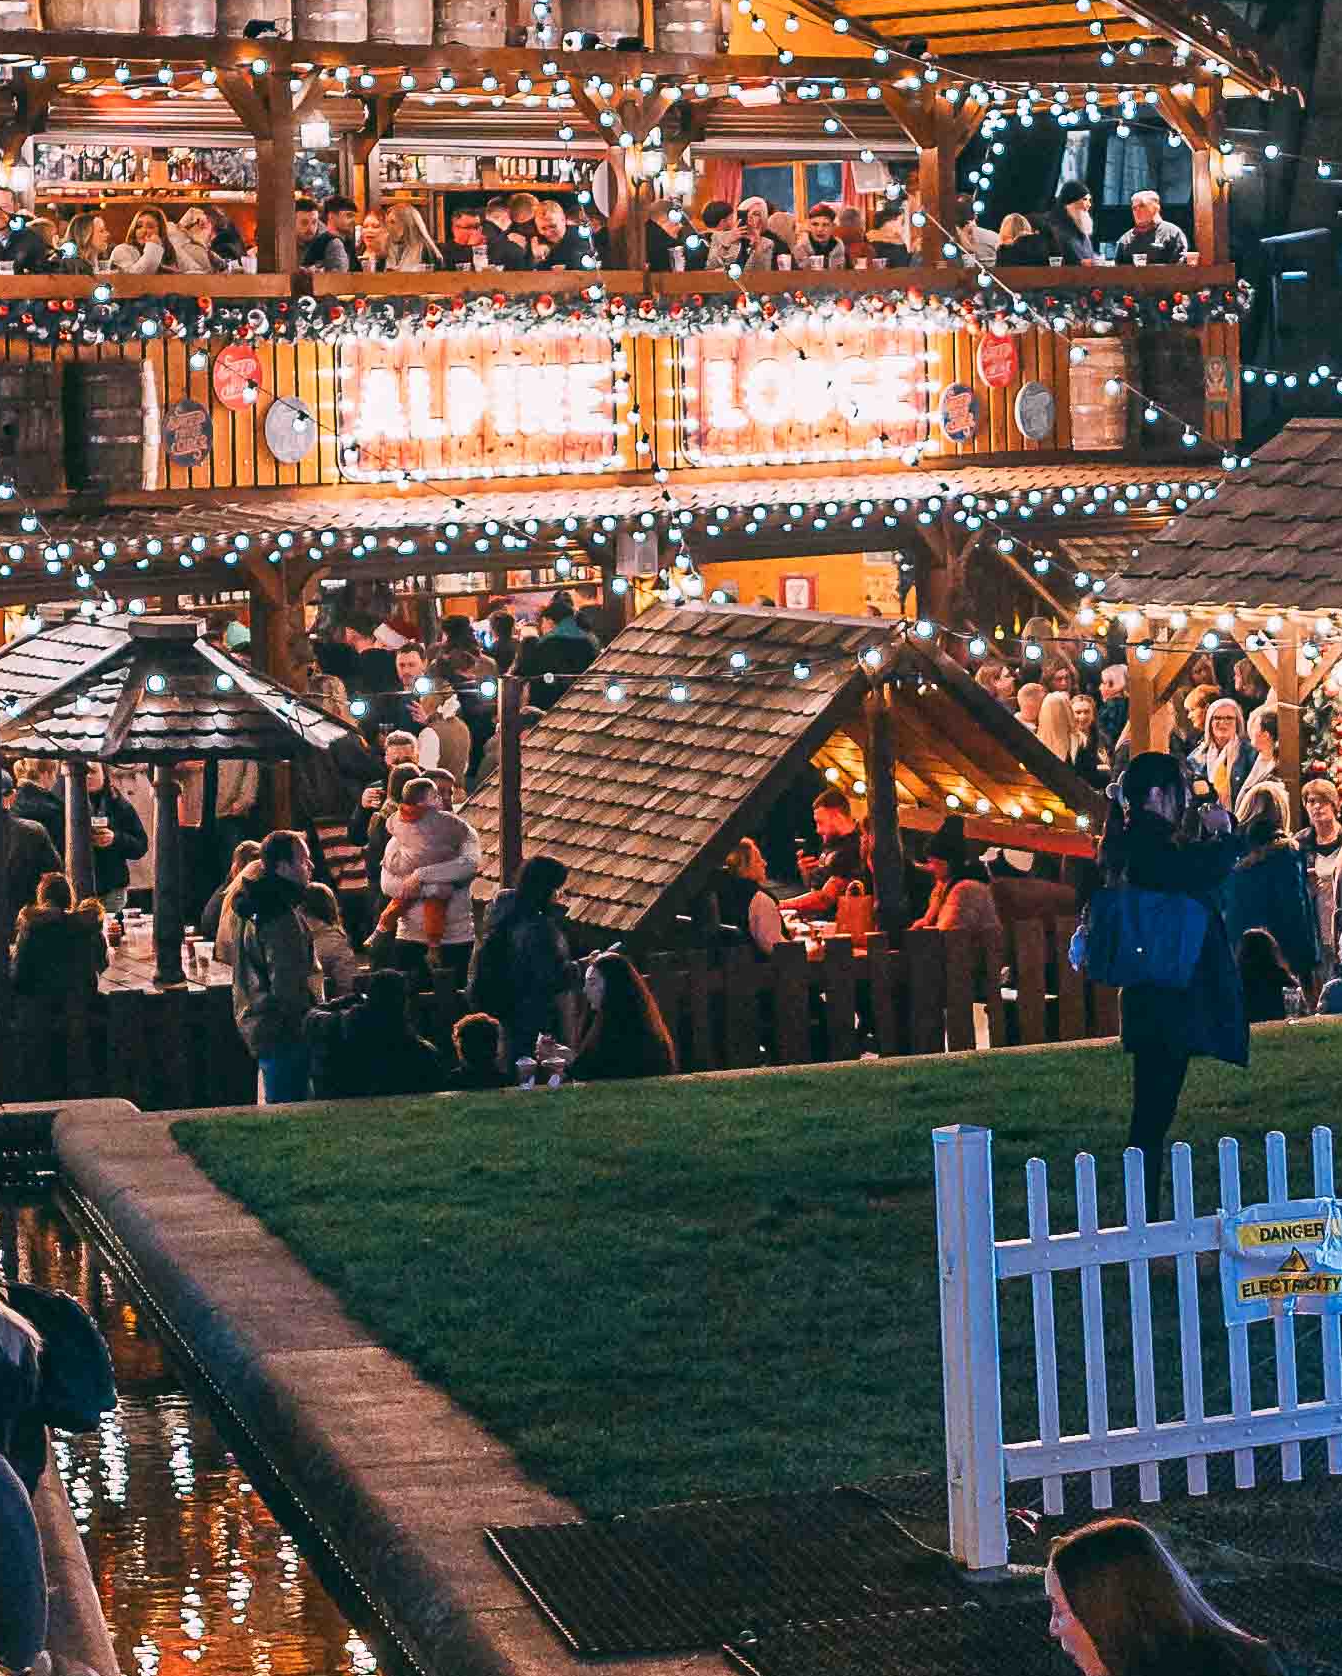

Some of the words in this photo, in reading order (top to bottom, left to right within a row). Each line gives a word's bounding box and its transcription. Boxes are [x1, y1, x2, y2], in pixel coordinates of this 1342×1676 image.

[359, 365, 608, 437] ALPINE
[704, 355, 916, 427] LODGE
[1260, 1222, 1326, 1242] DANGER
[1241, 1275, 1342, 1299] ELECTRICITY
